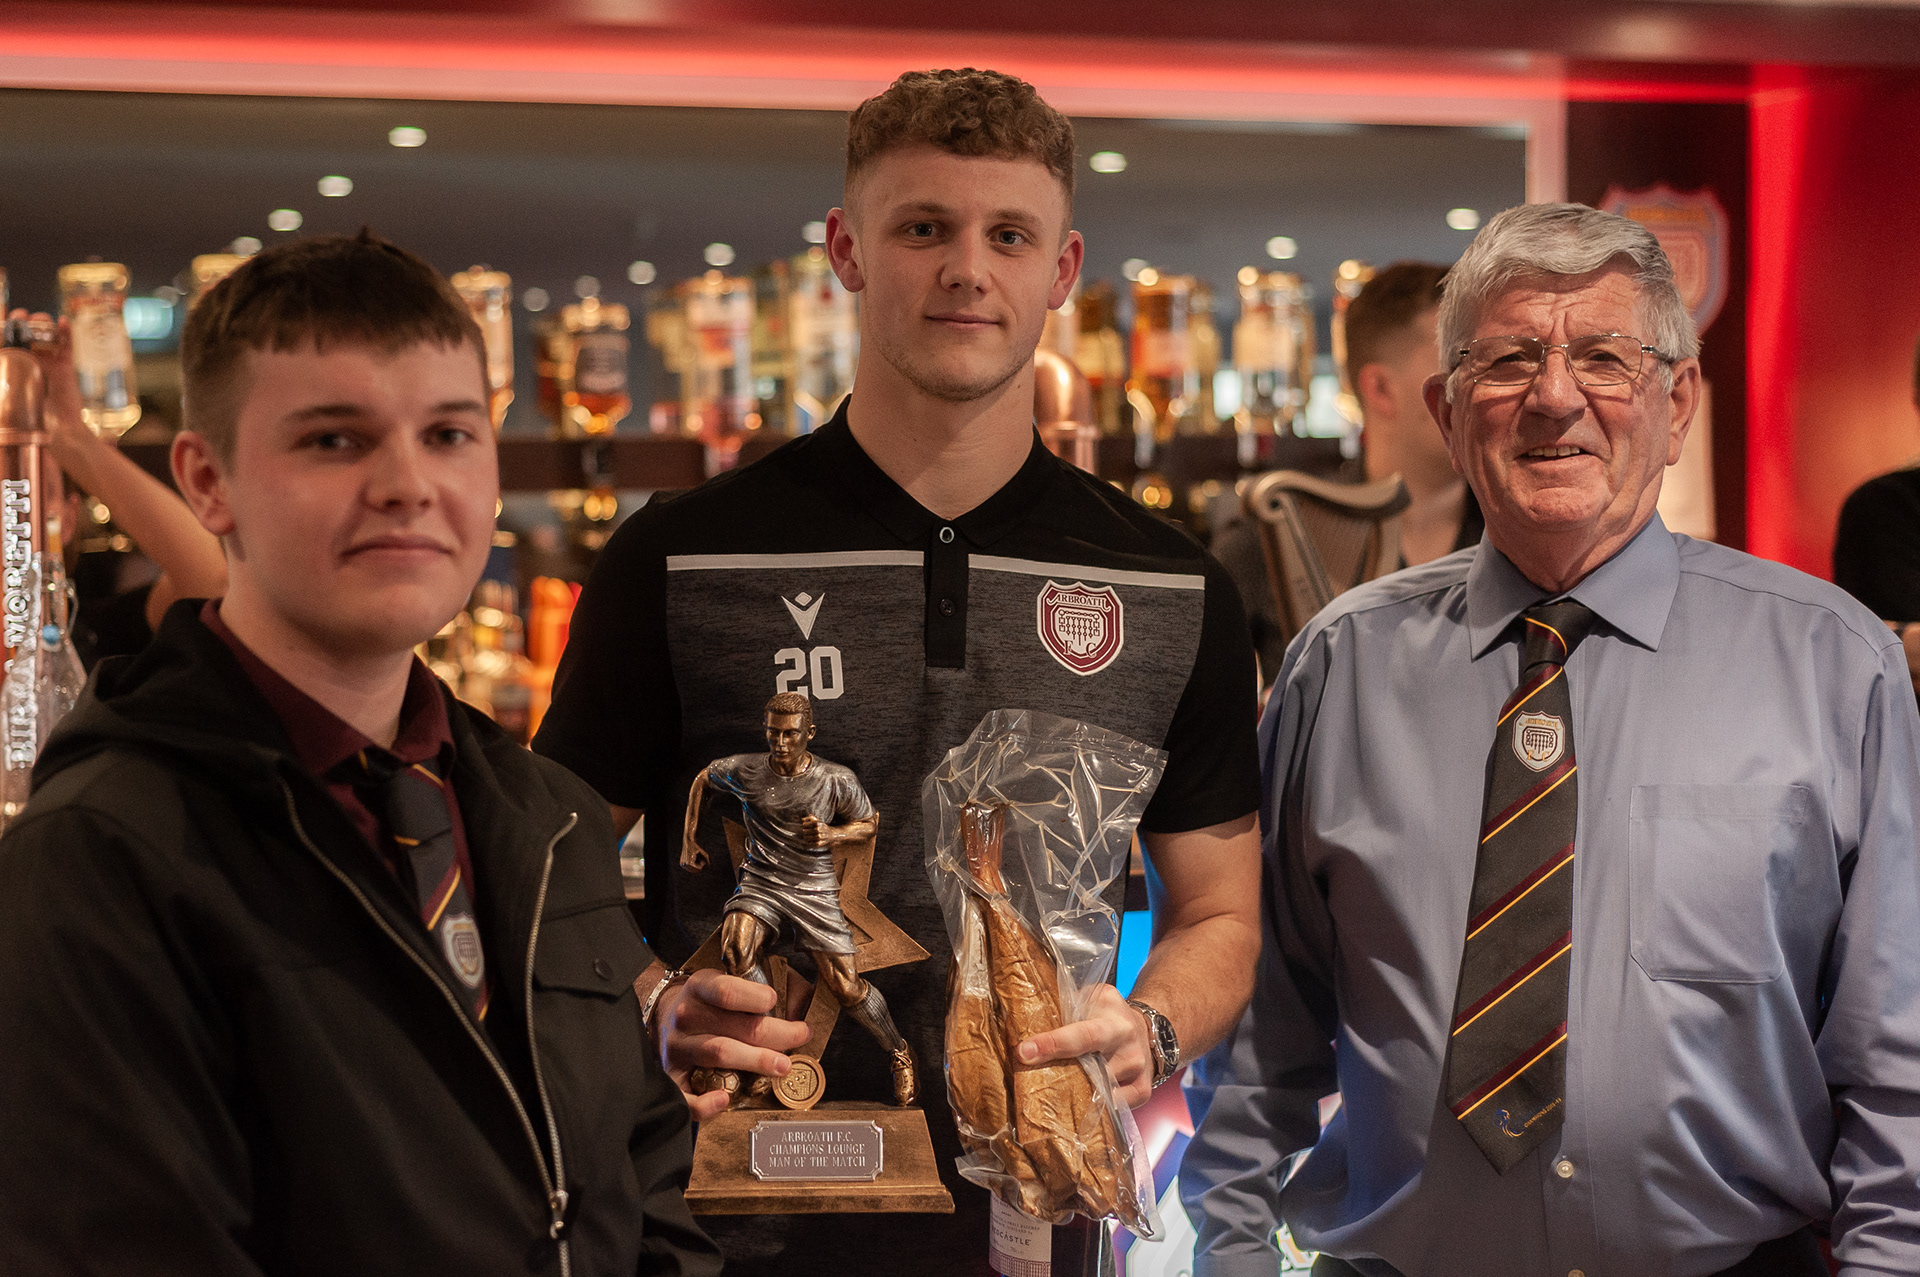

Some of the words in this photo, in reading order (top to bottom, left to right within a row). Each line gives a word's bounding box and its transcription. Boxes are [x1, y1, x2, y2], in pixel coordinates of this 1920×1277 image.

[2, 478, 31, 648] MORETTI
[1046, 592, 1112, 612] ARBROATH
[1063, 640, 1073, 655] F
[1086, 642, 1097, 658] C
[774, 646, 844, 700] 20
[781, 1131, 833, 1142] ARBROATH
[837, 1131, 854, 1142] F.C.
[769, 1144, 824, 1155] CHAMPIONS
[828, 1143, 865, 1154] LOUNGE
[769, 1156, 790, 1167] MAN
[794, 1156, 806, 1167] OF
[810, 1156, 828, 1167] THE
[832, 1156, 866, 1167] MATCH
